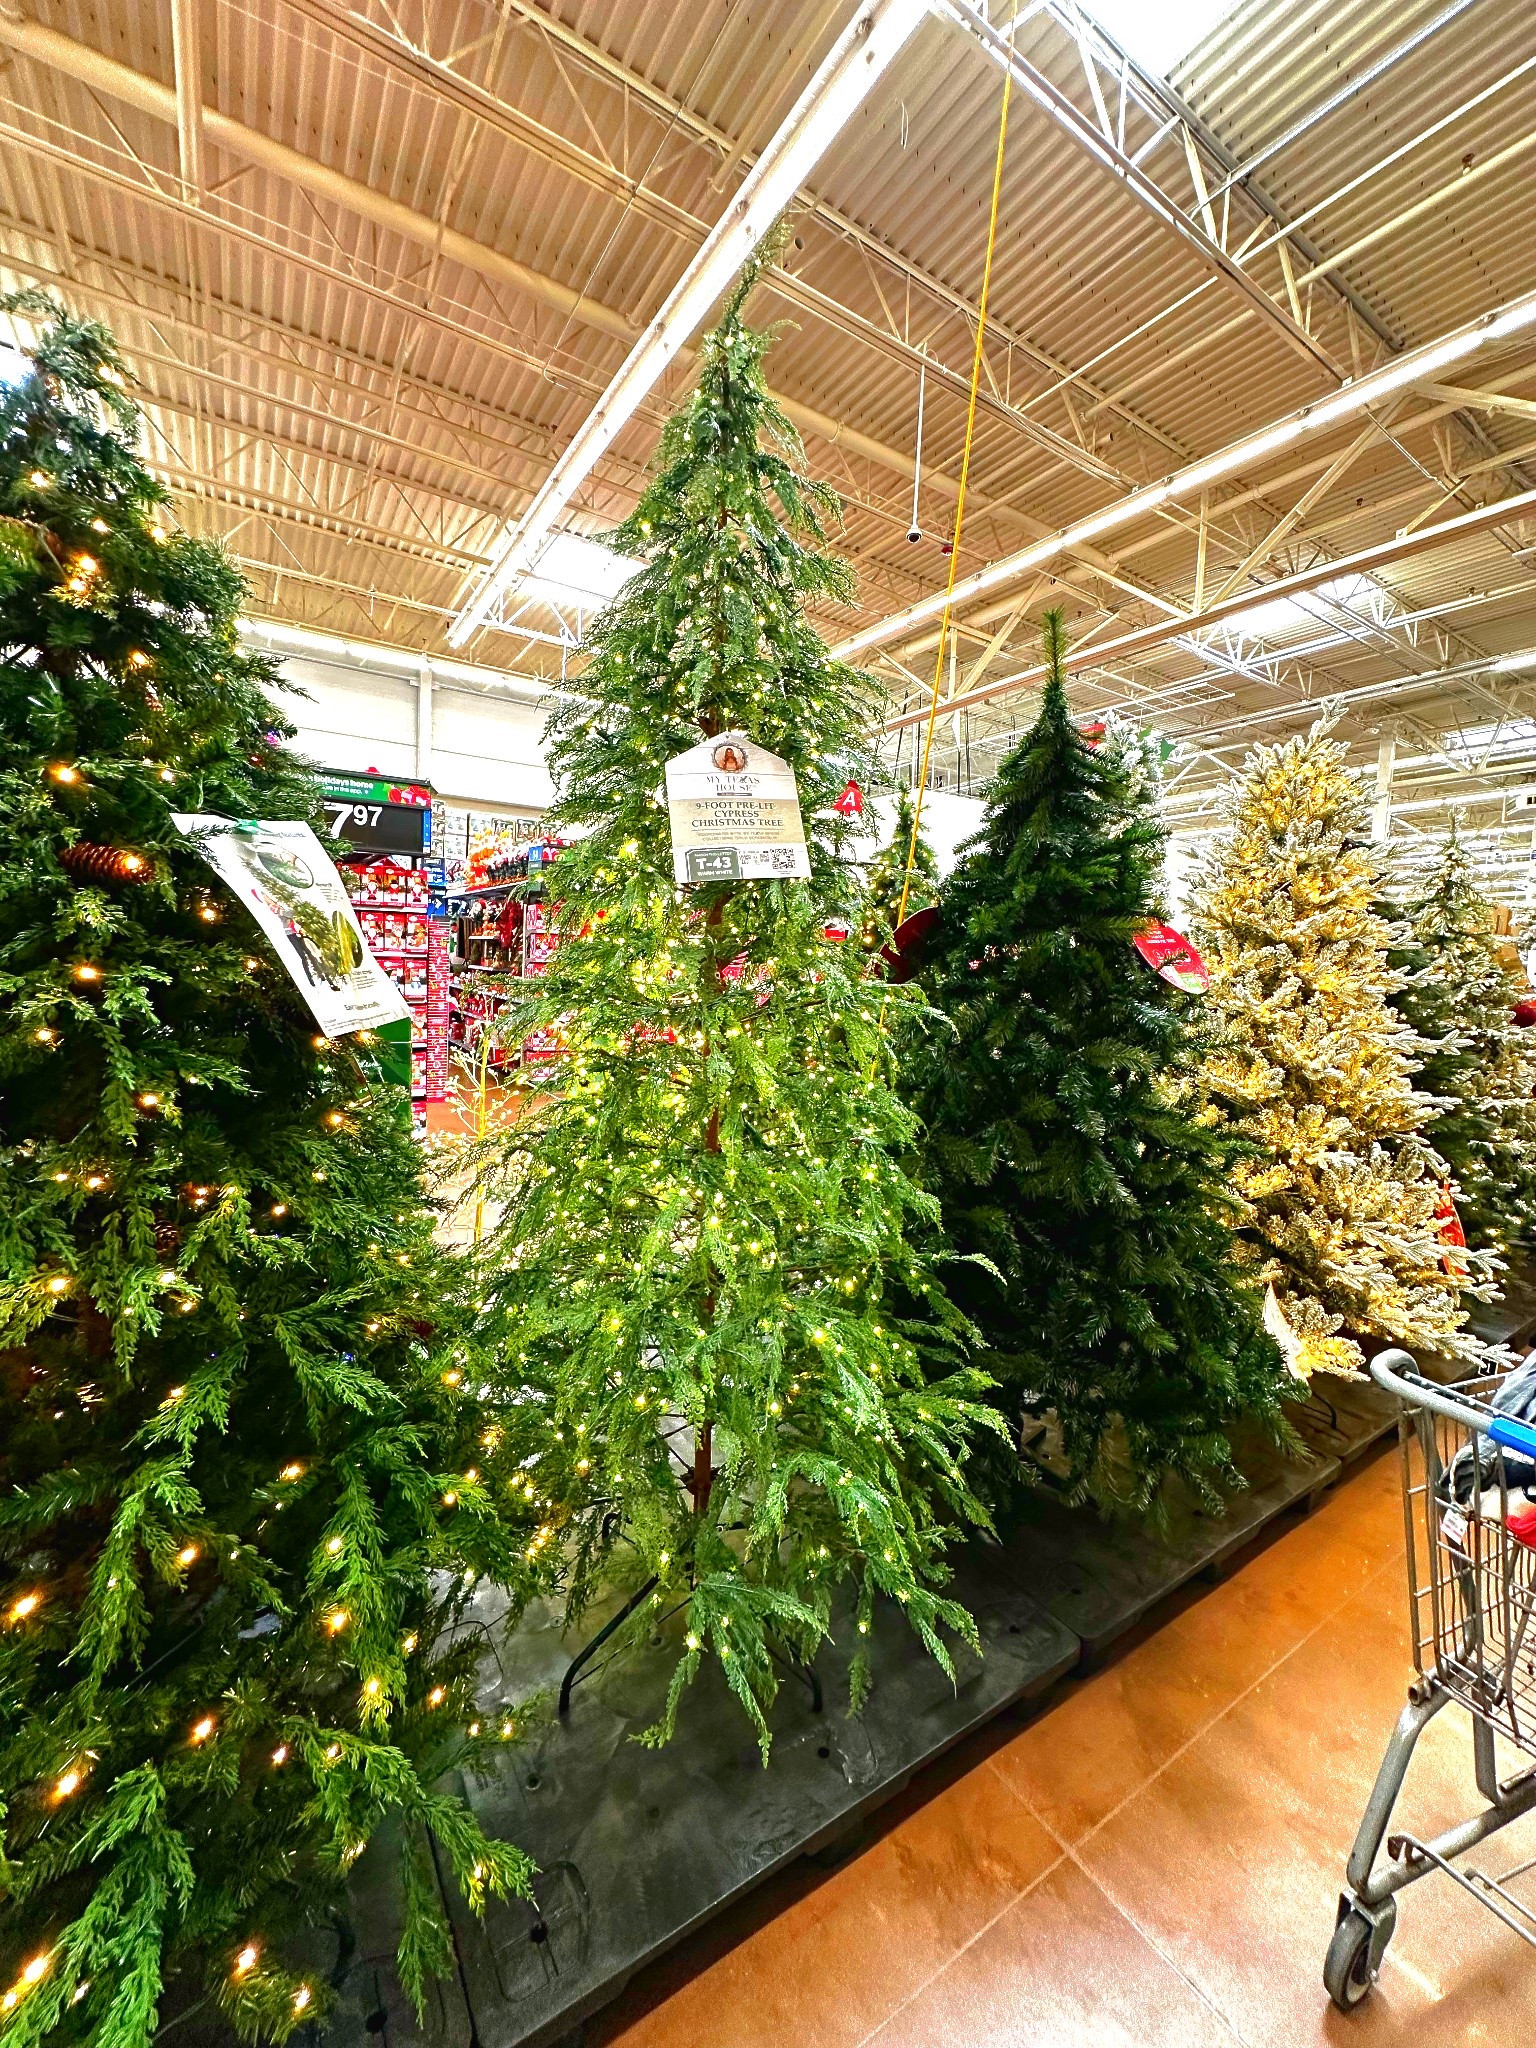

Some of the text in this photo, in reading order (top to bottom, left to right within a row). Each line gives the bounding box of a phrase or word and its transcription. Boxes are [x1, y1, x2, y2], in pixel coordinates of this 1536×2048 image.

[706, 775, 761, 784] MY TEXAS
[350, 780, 373, 789] home
[716, 783, 752, 792] HOUSE
[842, 792, 855, 806] A
[696, 801, 774, 810] 9-FOOT PRE-LIT
[714, 810, 760, 818] CYPRESS
[691, 818, 783, 828] CHRISTMAS TREE
[696, 857, 731, 869] T-43
